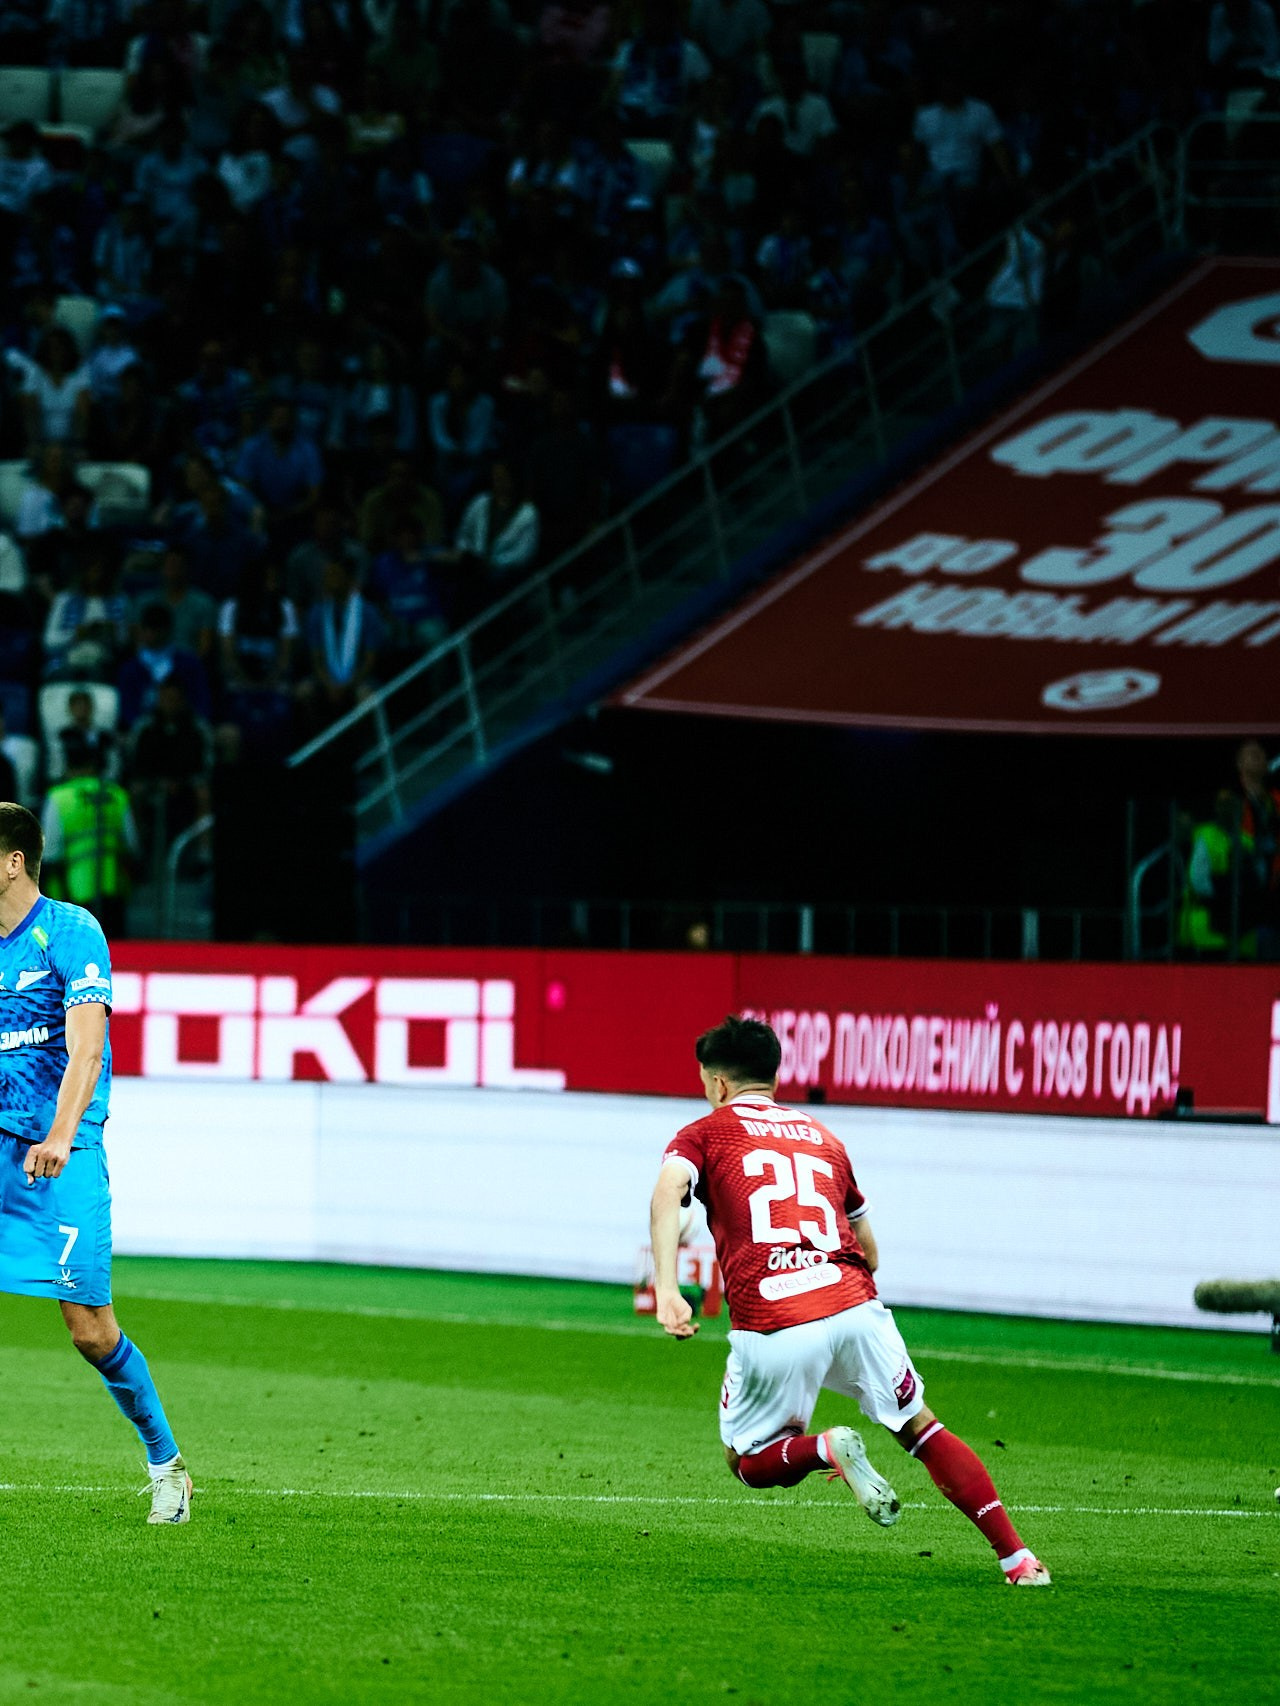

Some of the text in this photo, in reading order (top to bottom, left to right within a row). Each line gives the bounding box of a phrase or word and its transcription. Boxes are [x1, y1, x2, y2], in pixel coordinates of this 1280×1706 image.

[832, 1002, 1001, 1096] ПОКОЛЕНИЙ
[1031, 1020, 1089, 1099] 1968
[1092, 1021, 1182, 1117] ГОДА!
[739, 1119, 824, 1146] ПРУЦЕВ
[741, 1148, 842, 1253] 25
[58, 1224, 79, 1266] 7
